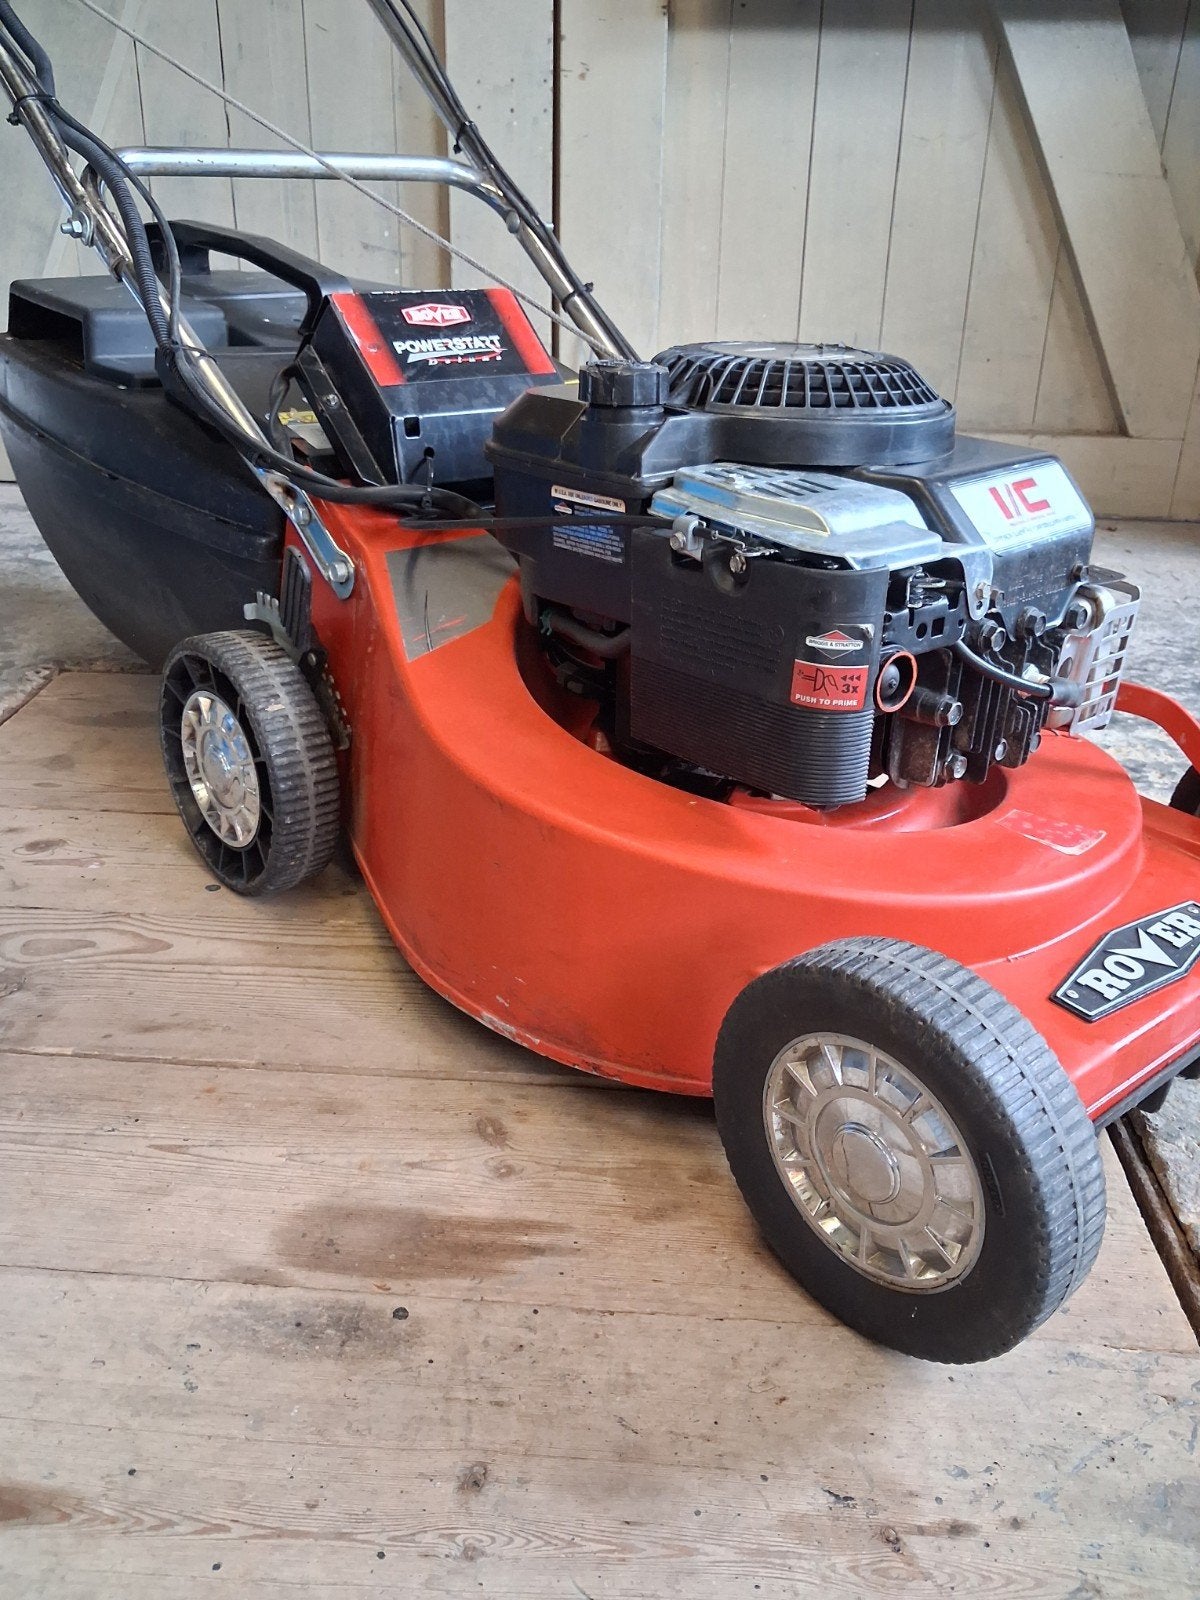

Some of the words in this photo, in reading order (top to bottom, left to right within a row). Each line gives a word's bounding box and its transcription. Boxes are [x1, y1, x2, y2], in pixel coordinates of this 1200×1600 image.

[392, 335, 502, 355] POWERSTART
[795, 693, 817, 703] PUSH
[819, 698, 831, 706] TO
[832, 699, 858, 707] PRIME
[1076, 911, 1200, 1001] ROVER
